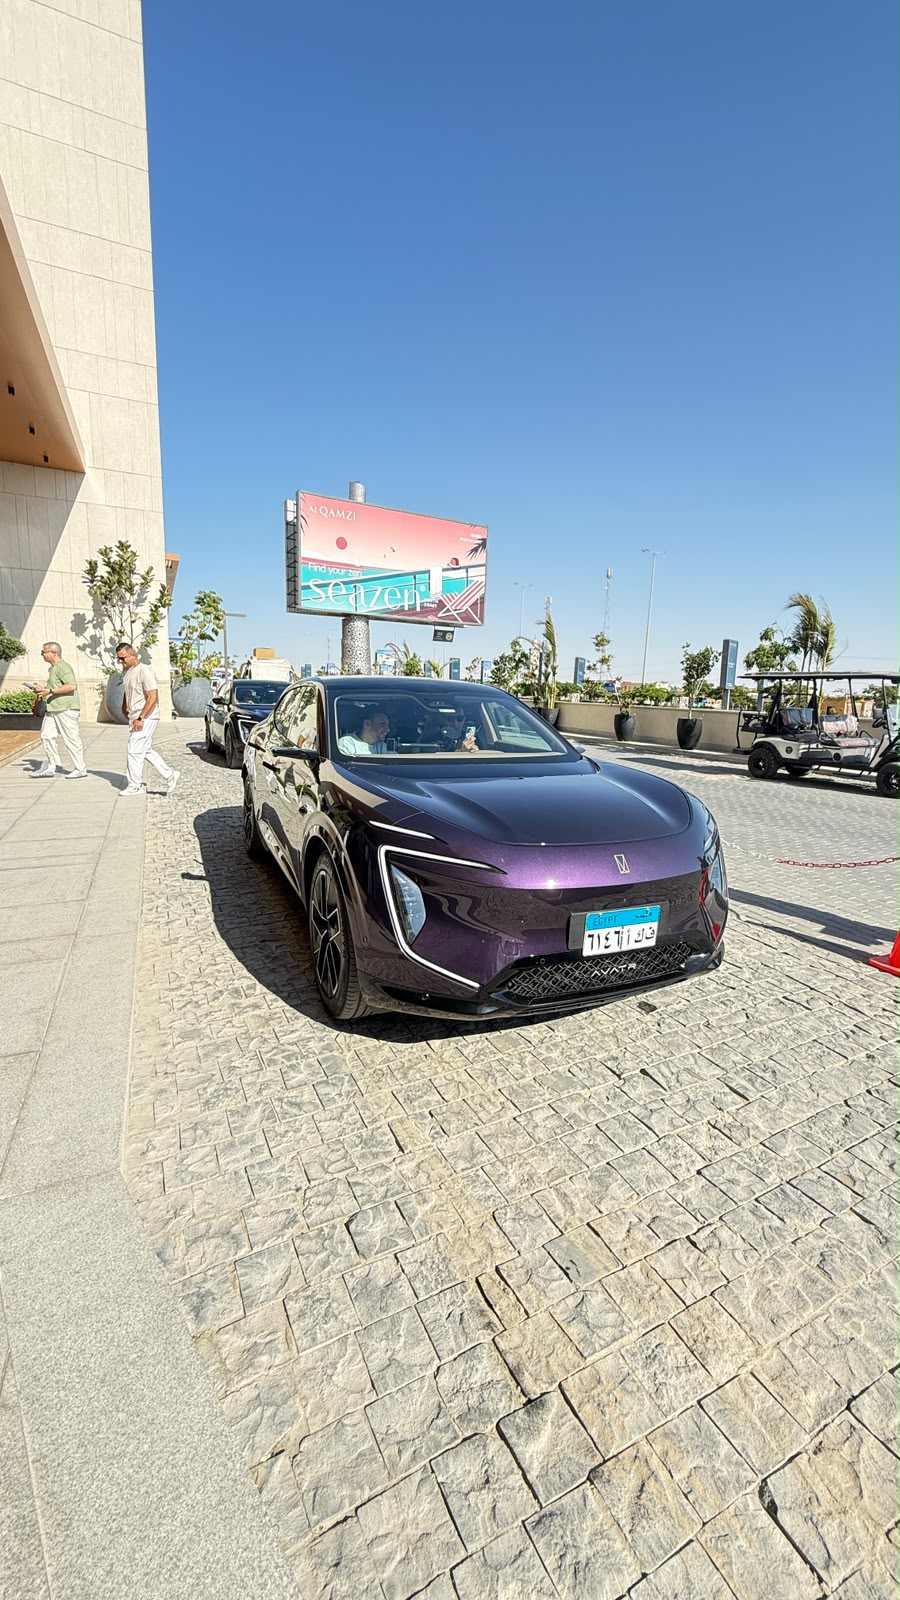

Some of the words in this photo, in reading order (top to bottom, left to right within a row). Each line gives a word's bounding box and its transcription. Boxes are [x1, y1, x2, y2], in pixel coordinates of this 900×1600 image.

[309, 505, 318, 513] AL
[319, 505, 356, 521] QAMZI
[308, 562, 327, 573] Find
[328, 566, 346, 576] your
[347, 569, 363, 577] zen
[593, 915, 618, 927] EGYPT
[587, 929, 621, 952] ٦١٤٦
[590, 963, 637, 978] AVATR
